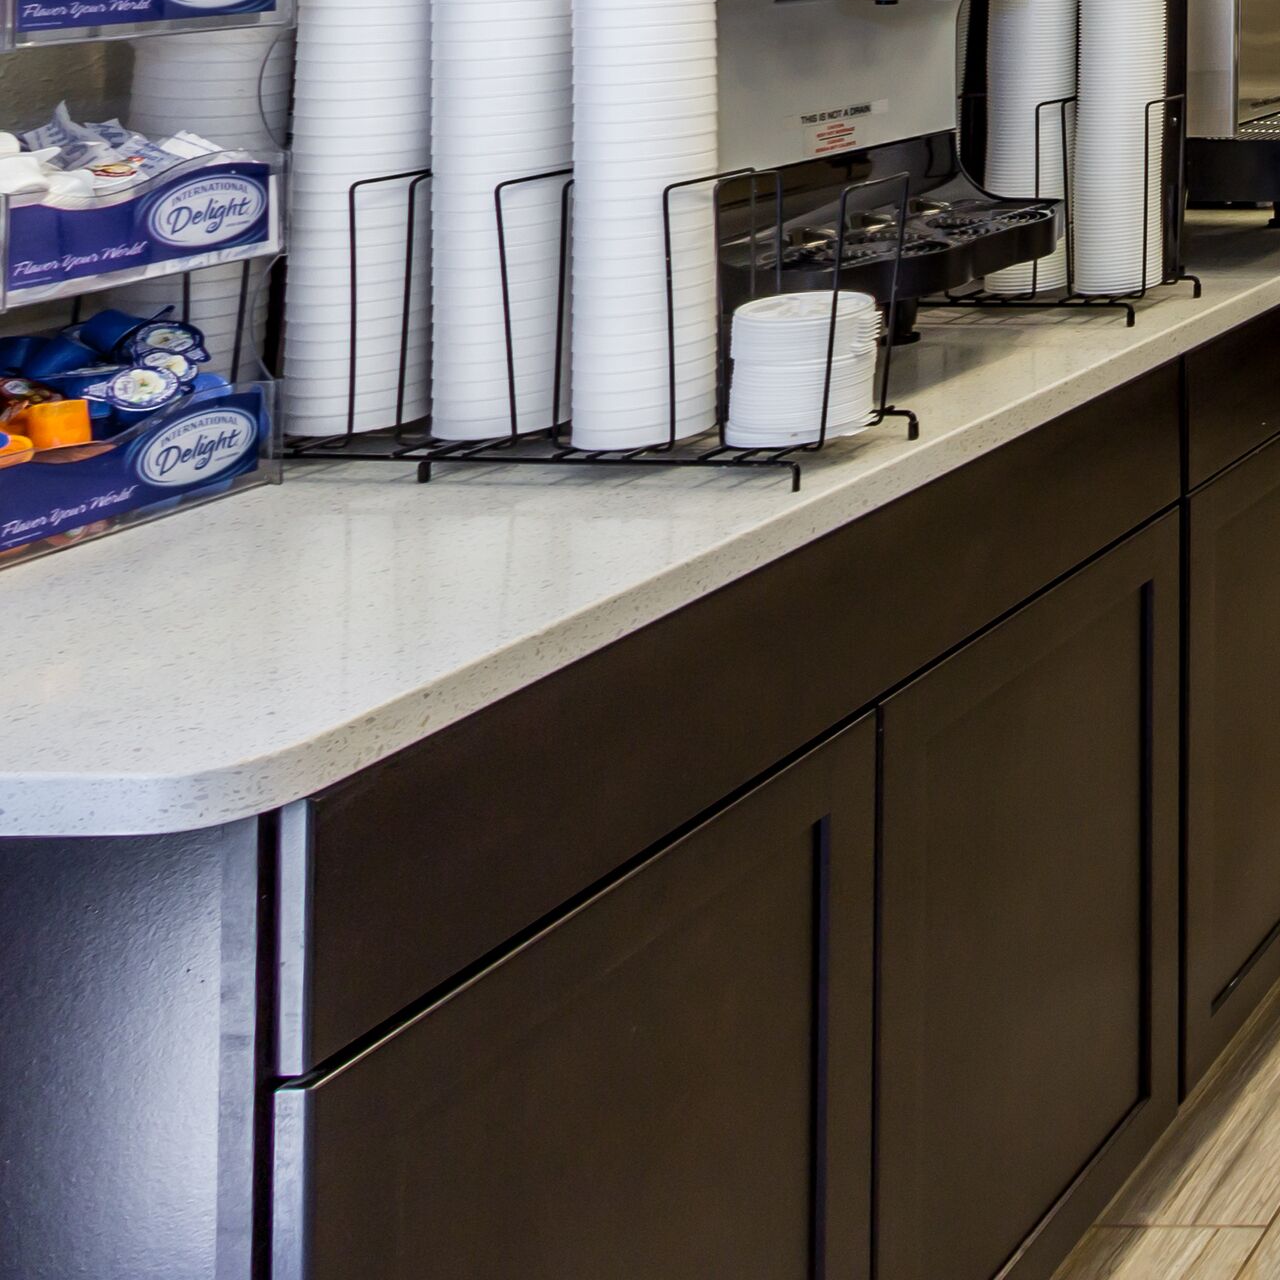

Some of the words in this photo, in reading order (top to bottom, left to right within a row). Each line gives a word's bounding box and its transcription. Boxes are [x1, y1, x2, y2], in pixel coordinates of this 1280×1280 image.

[22, 2, 67, 18] Flavor
[67, 1, 107, 18] Your
[800, 114, 817, 125] THIS
[818, 112, 827, 122] IS
[827, 109, 843, 120] NOT
[843, 108, 849, 117] A
[850, 104, 872, 117] DRAIN
[171, 182, 250, 206] INTERNATIONAL
[167, 196, 252, 236] Delight
[12, 260, 60, 278] Flavor
[60, 253, 101, 273] Your
[101, 240, 149, 261] World
[160, 414, 239, 448] INTERNATIONAL
[156, 428, 243, 476] Delight
[1, 516, 47, 538] Flavor
[48, 504, 88, 527] Your
[89, 484, 139, 511] World
